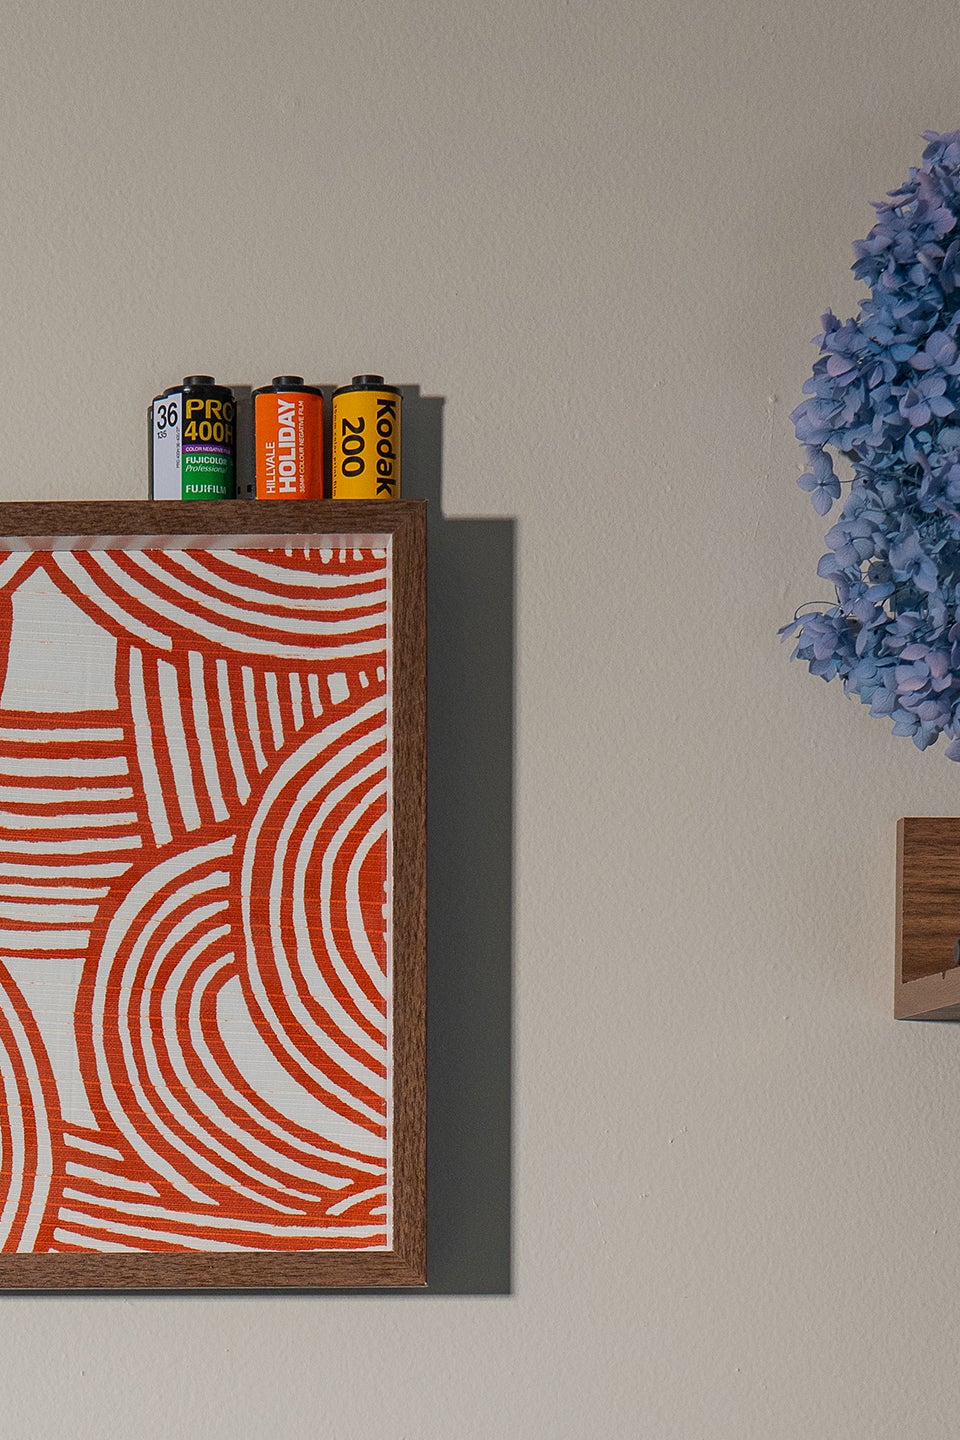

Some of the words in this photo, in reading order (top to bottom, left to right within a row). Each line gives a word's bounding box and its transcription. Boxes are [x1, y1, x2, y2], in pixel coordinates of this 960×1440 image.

[157, 402, 178, 430] 36
[185, 398, 233, 421] PRO
[184, 420, 233, 444] 400H
[277, 399, 297, 493] HOLIDAY
[342, 416, 366, 478] 200
[376, 399, 397, 496] Kodak
[265, 442, 276, 494] HILLVALE
[185, 484, 227, 494] FUJIFILM
